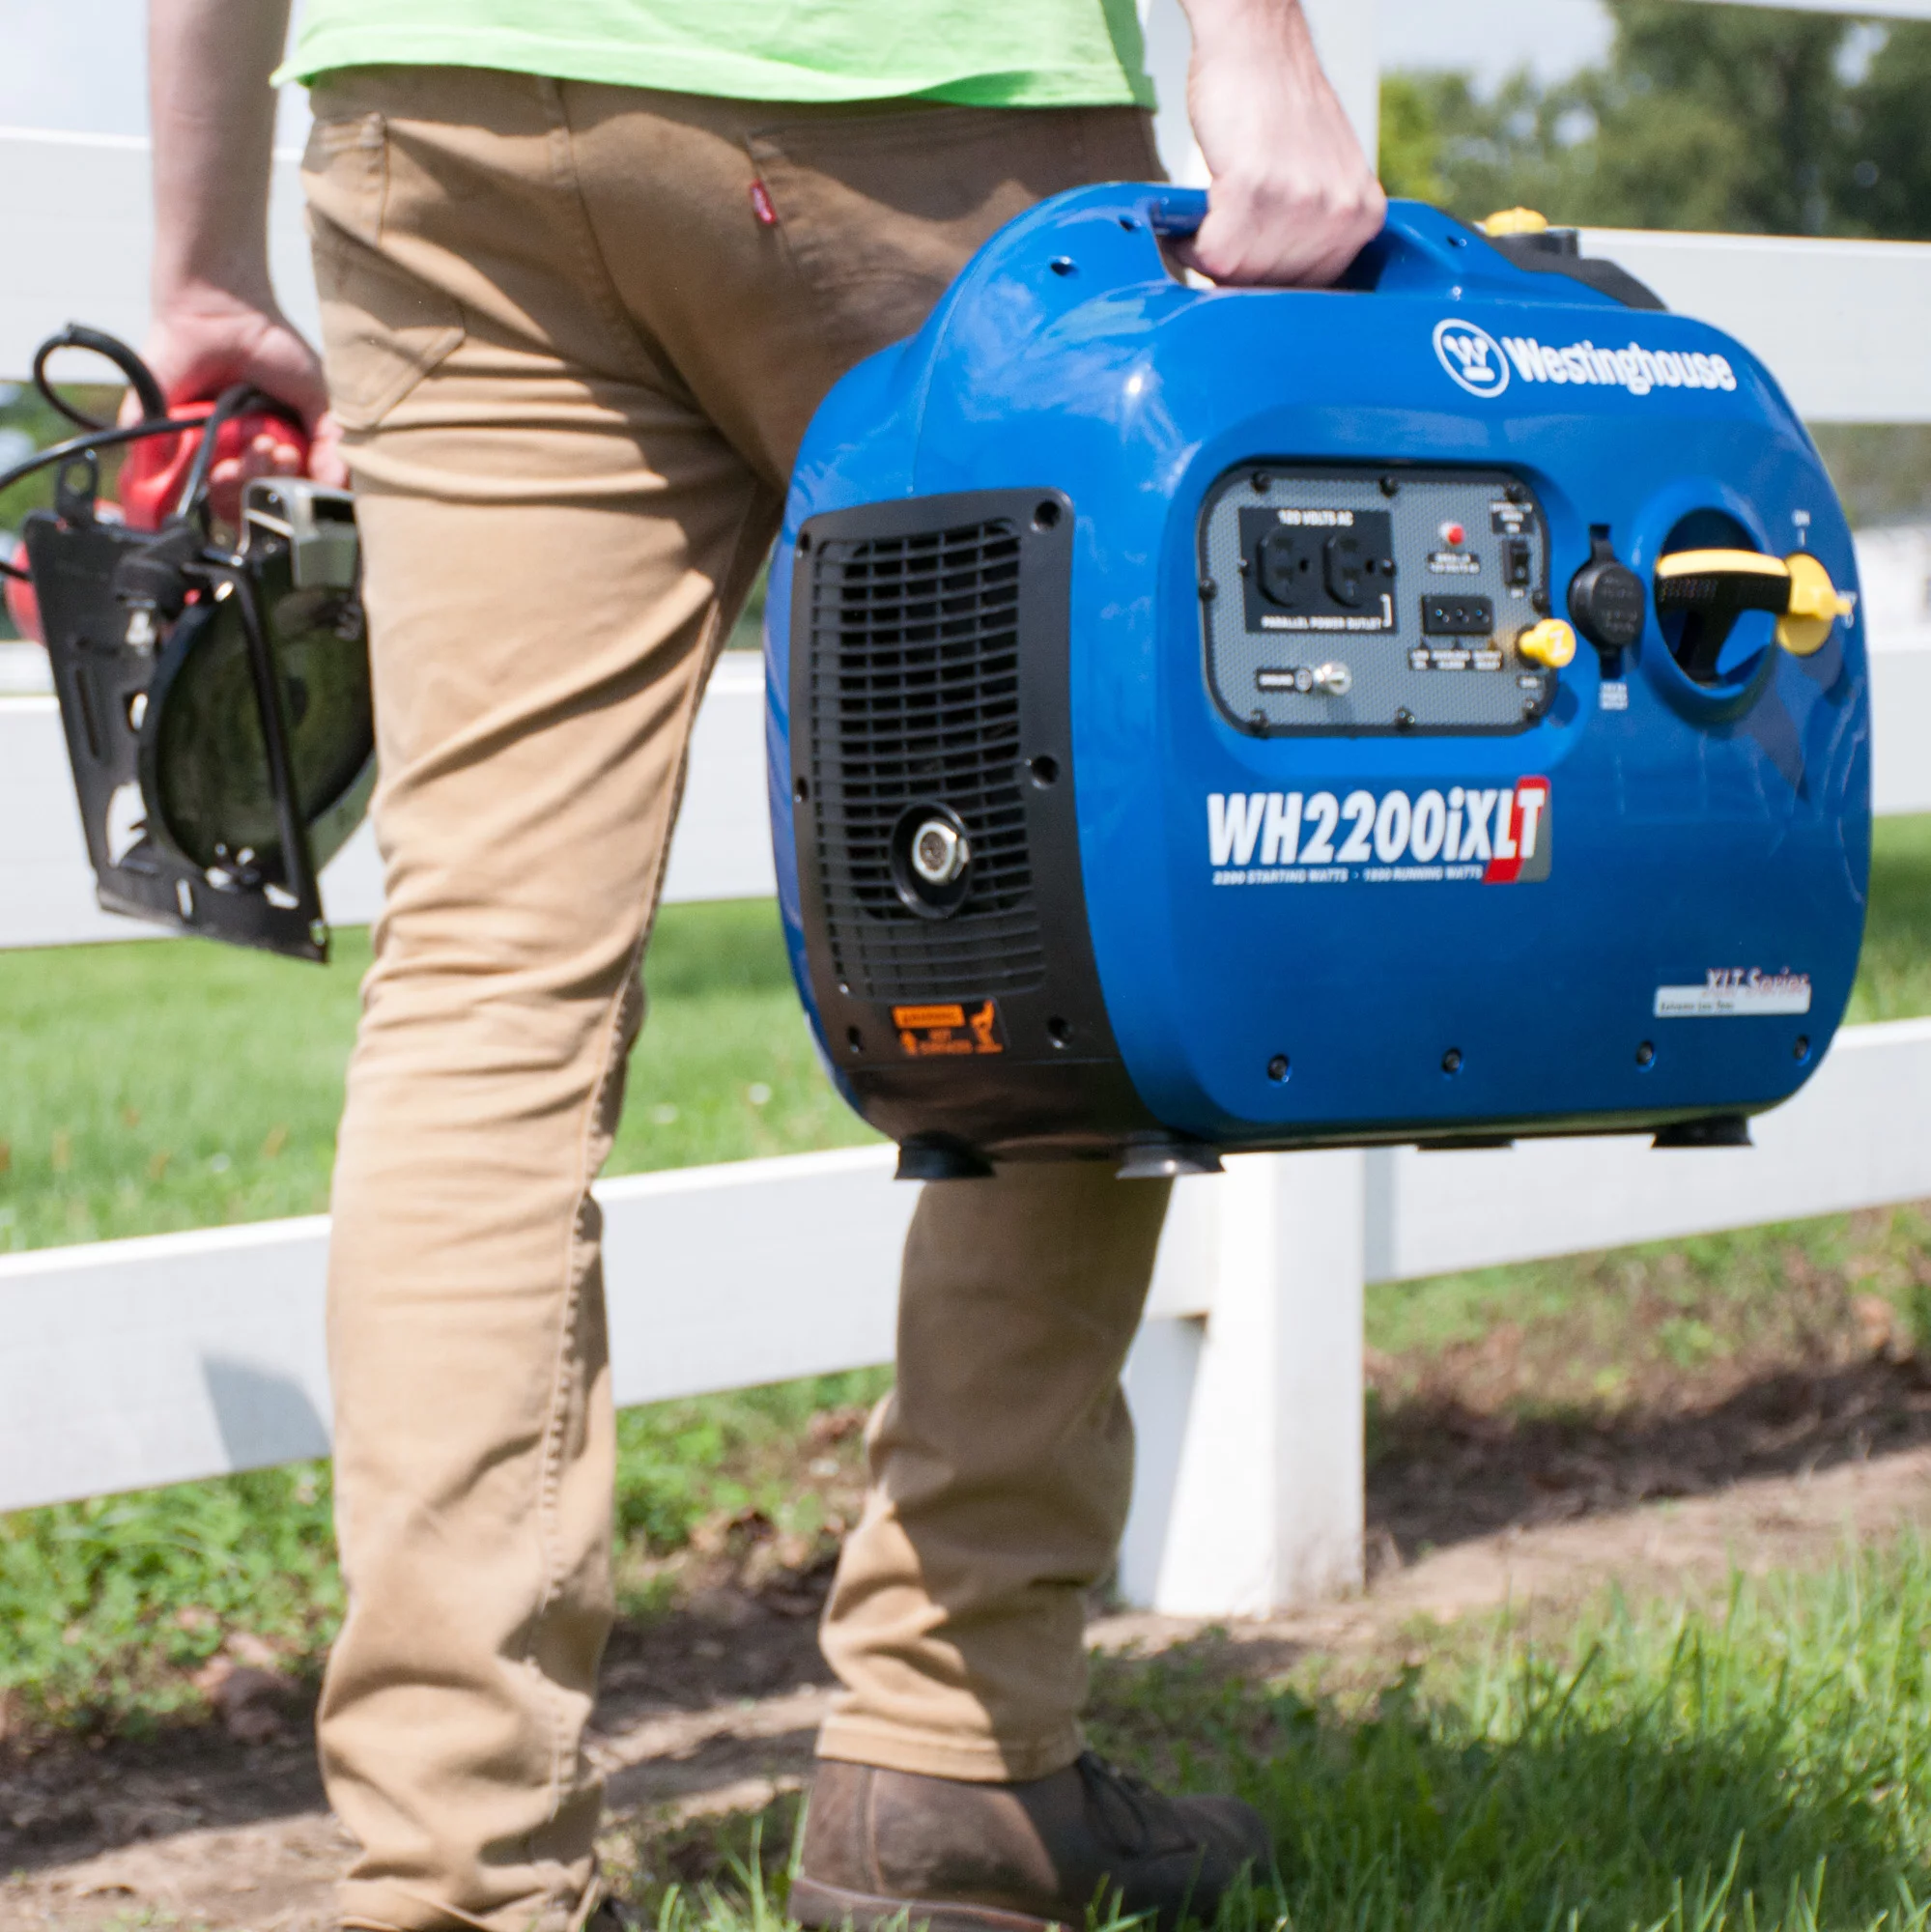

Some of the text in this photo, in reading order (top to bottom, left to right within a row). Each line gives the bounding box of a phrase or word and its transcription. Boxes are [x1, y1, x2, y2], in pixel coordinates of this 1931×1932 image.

[1500, 336, 1737, 395] Westinghouse
[1301, 509, 1337, 526] VOLTS
[1346, 616, 1380, 631] OUTLET
[1207, 786, 1546, 866] WH2200iXLT
[1247, 868, 1306, 885] STARTING
[1309, 867, 1349, 883] WATTS
[1445, 865, 1483, 880] WATTS
[1746, 966, 1810, 997] Series
